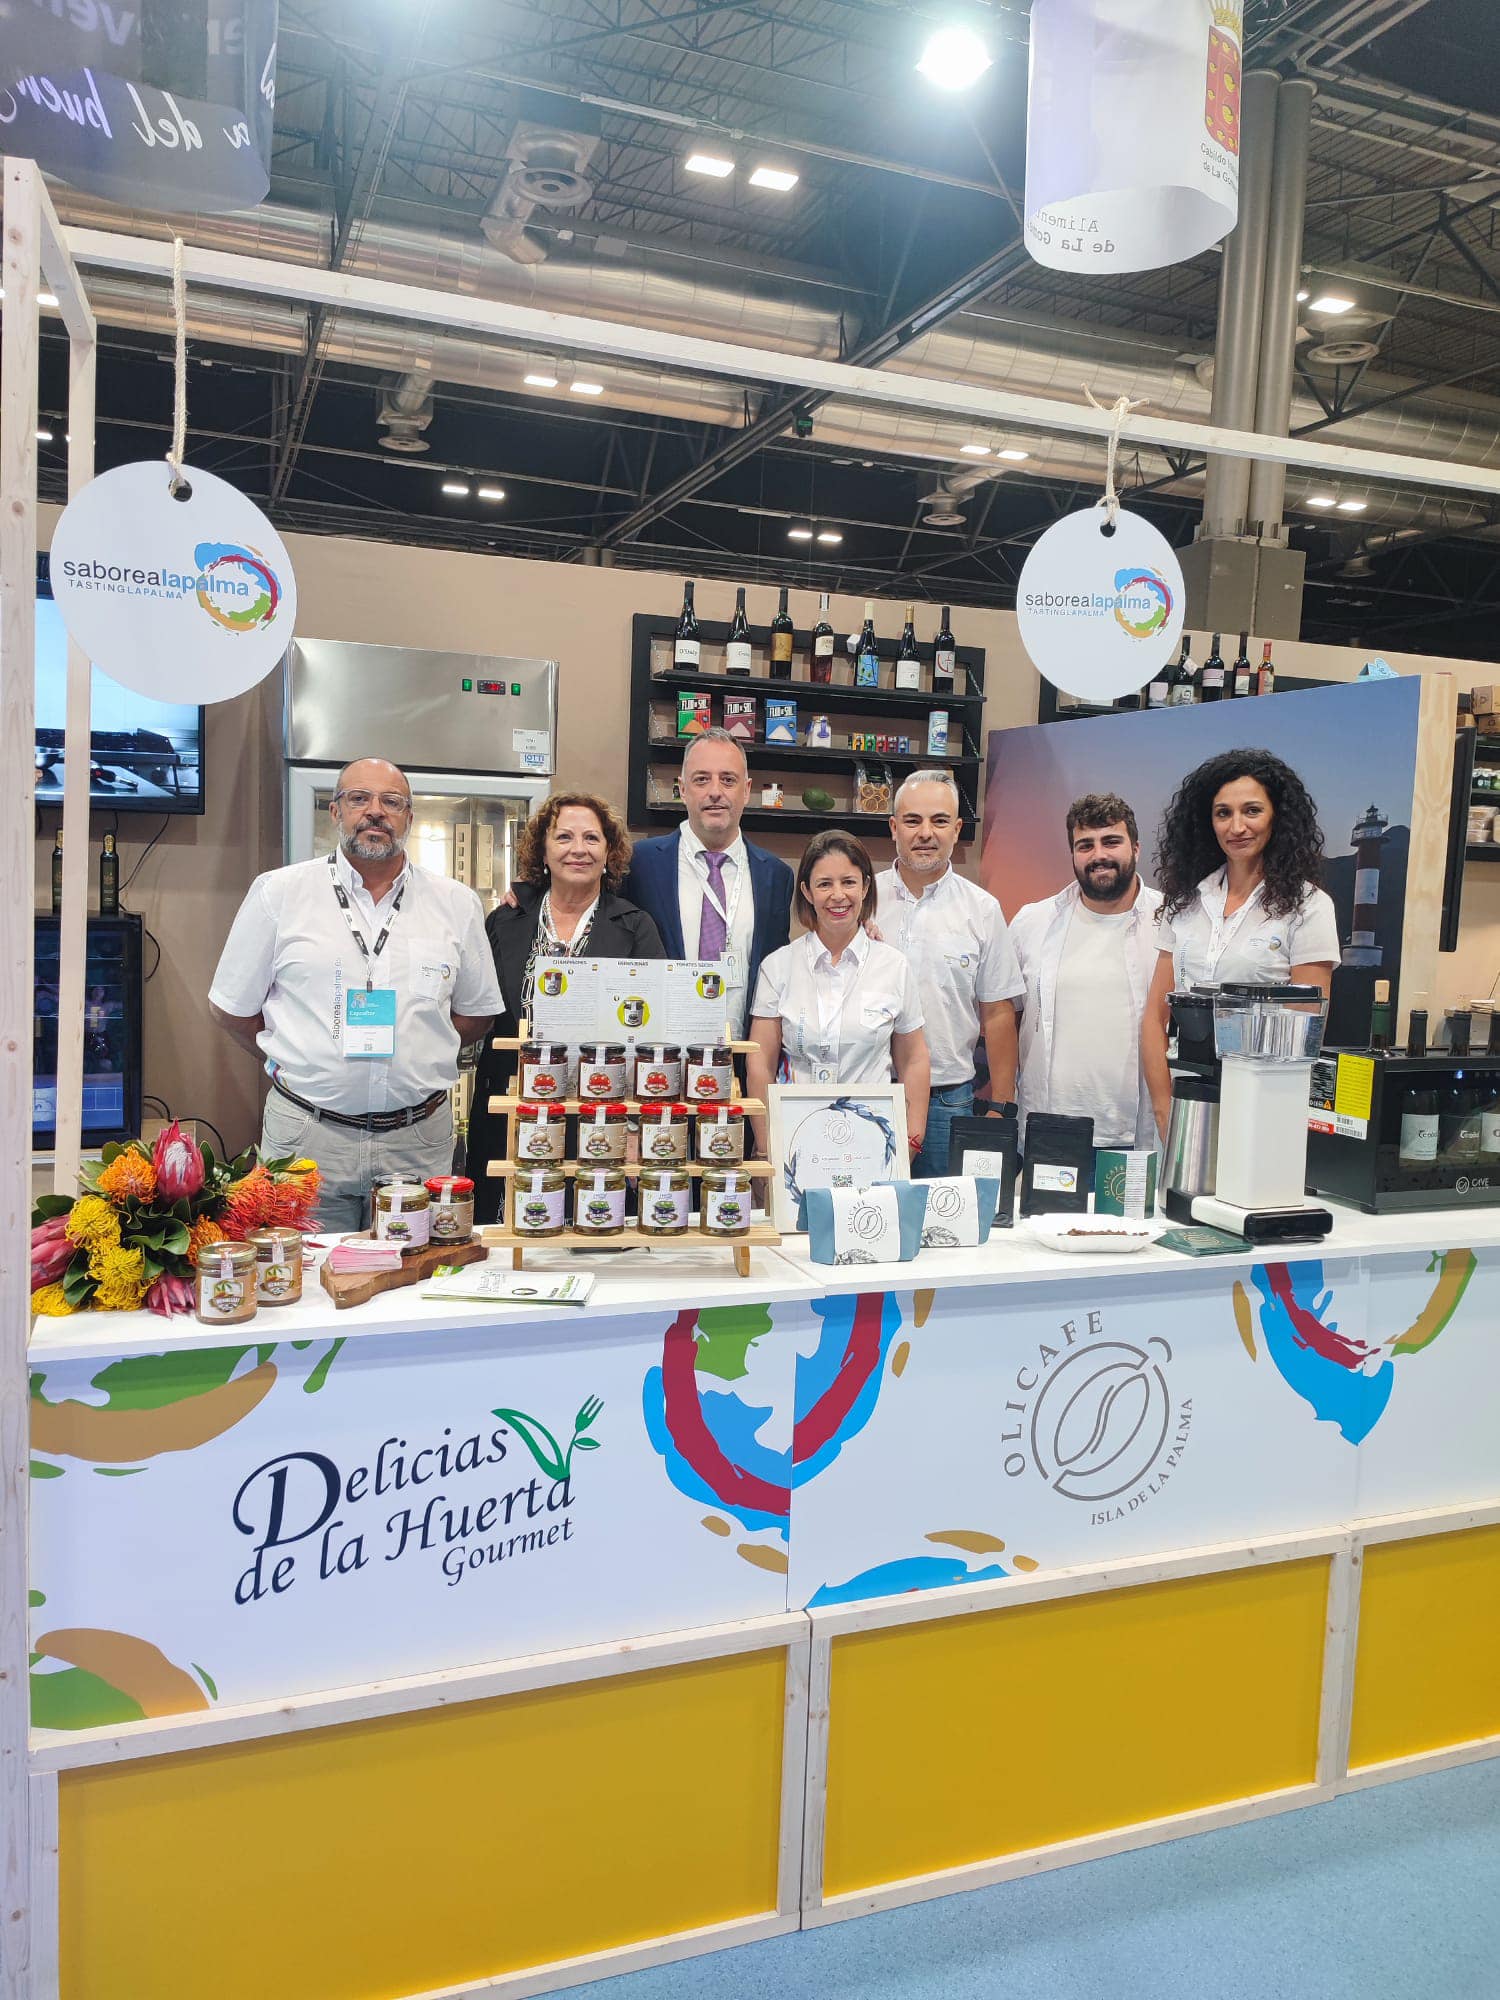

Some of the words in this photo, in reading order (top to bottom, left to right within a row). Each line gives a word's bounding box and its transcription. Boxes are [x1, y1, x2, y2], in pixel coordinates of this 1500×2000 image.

[1200, 142, 1226, 166] Cabildo
[1203, 159, 1211, 173] de
[1211, 165, 1221, 178] La
[63, 559, 249, 597] saborealapalma
[68, 578, 183, 600] TASTINGLAPALMA
[1025, 591, 1151, 611] saborealapalma
[1001, 1310, 1104, 1478] OLICAFE
[1091, 1506, 1125, 1526] ISLA
[1127, 1490, 1149, 1512] DE
[1147, 1472, 1170, 1495] LA
[1166, 1397, 1193, 1468] PALMA
[232, 1426, 509, 1552] Delicias
[234, 1547, 296, 1605] de
[319, 1520, 369, 1580] la
[385, 1473, 577, 1561] Huerta
[441, 1516, 575, 1587] Gourmet
